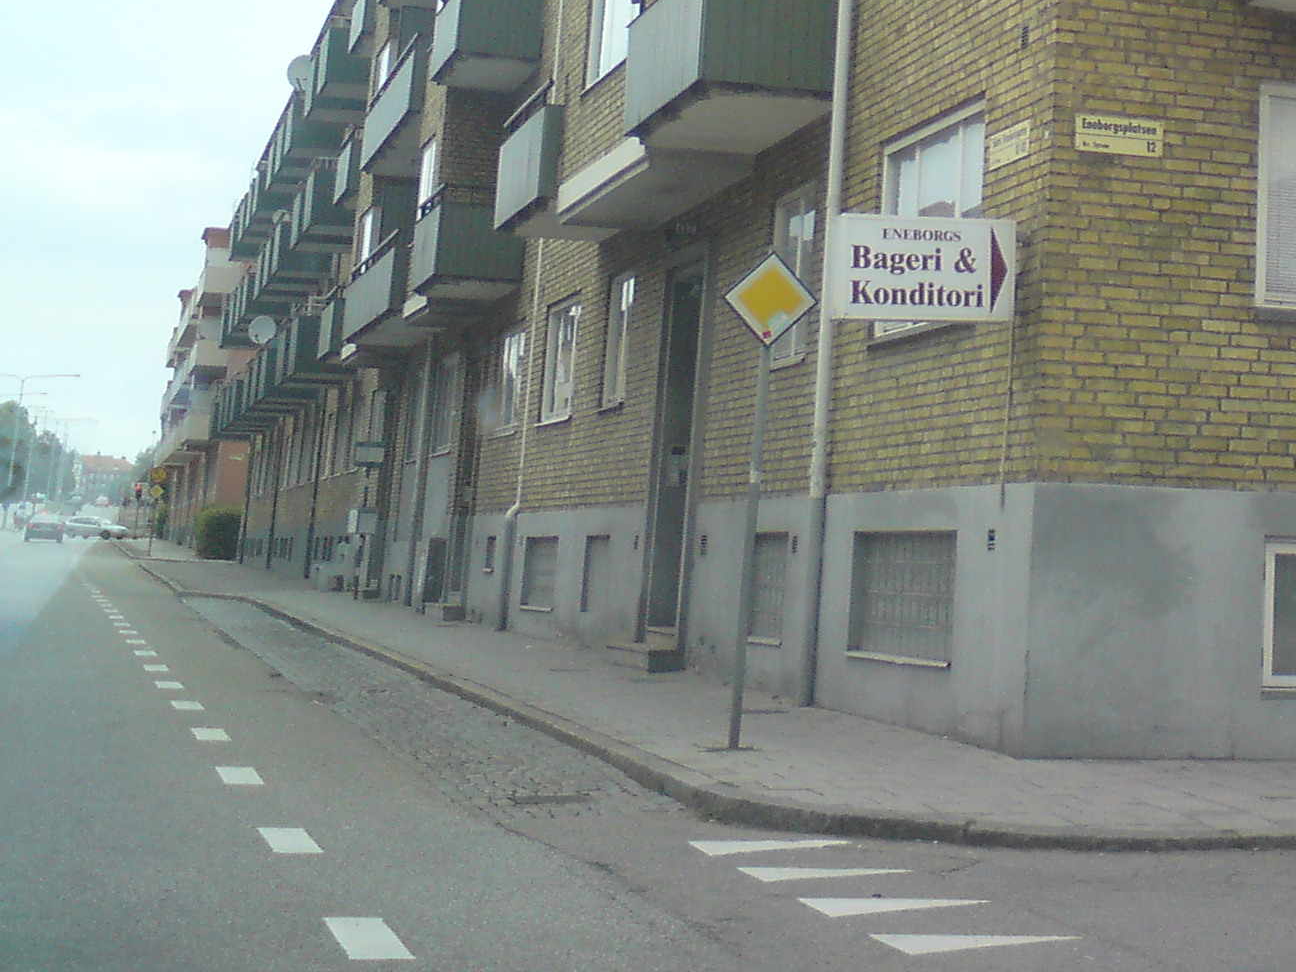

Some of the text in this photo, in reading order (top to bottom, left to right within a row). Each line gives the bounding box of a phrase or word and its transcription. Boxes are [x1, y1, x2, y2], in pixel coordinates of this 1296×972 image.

[1082, 117, 1157, 135] Eneborgsplatsen
[1146, 141, 1156, 153] 12
[882, 227, 962, 242] ENEBORGS
[850, 244, 977, 275] Bageri &
[849, 279, 985, 308] Konditori
